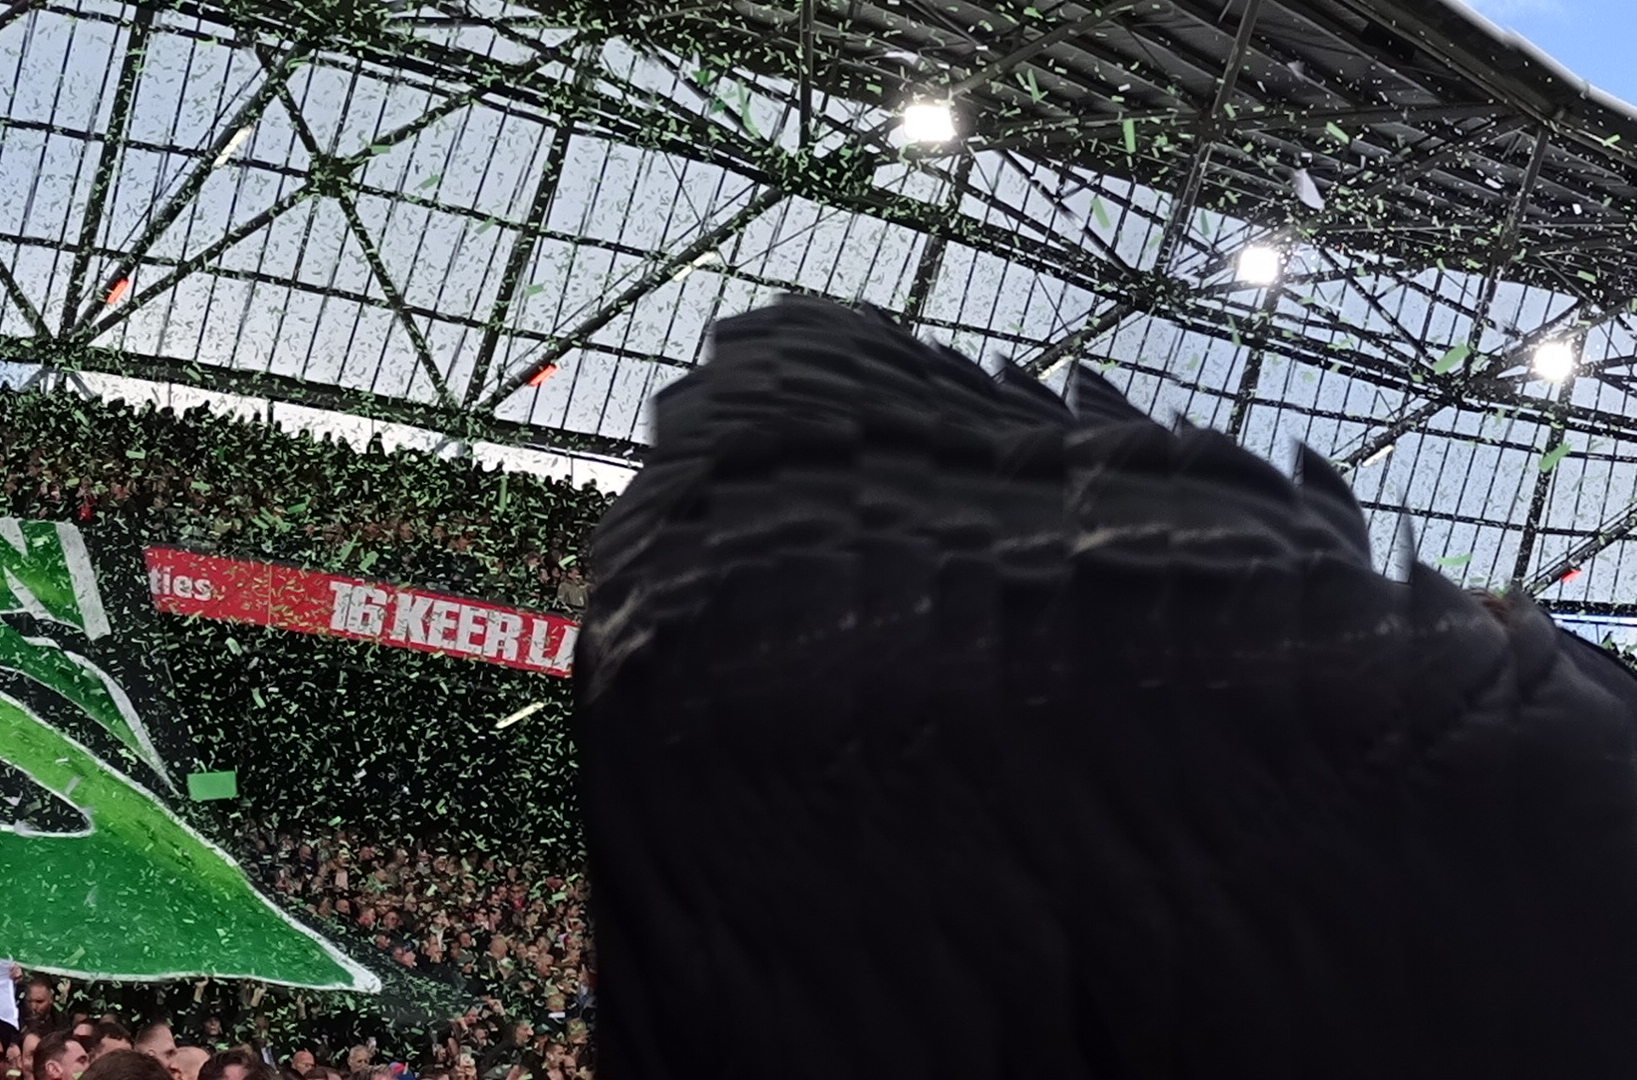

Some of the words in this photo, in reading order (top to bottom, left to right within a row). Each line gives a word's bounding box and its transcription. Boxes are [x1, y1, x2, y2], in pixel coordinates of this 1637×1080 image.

[148, 565, 212, 601] ties
[329, 580, 388, 637] 16
[389, 592, 523, 661] KEER
